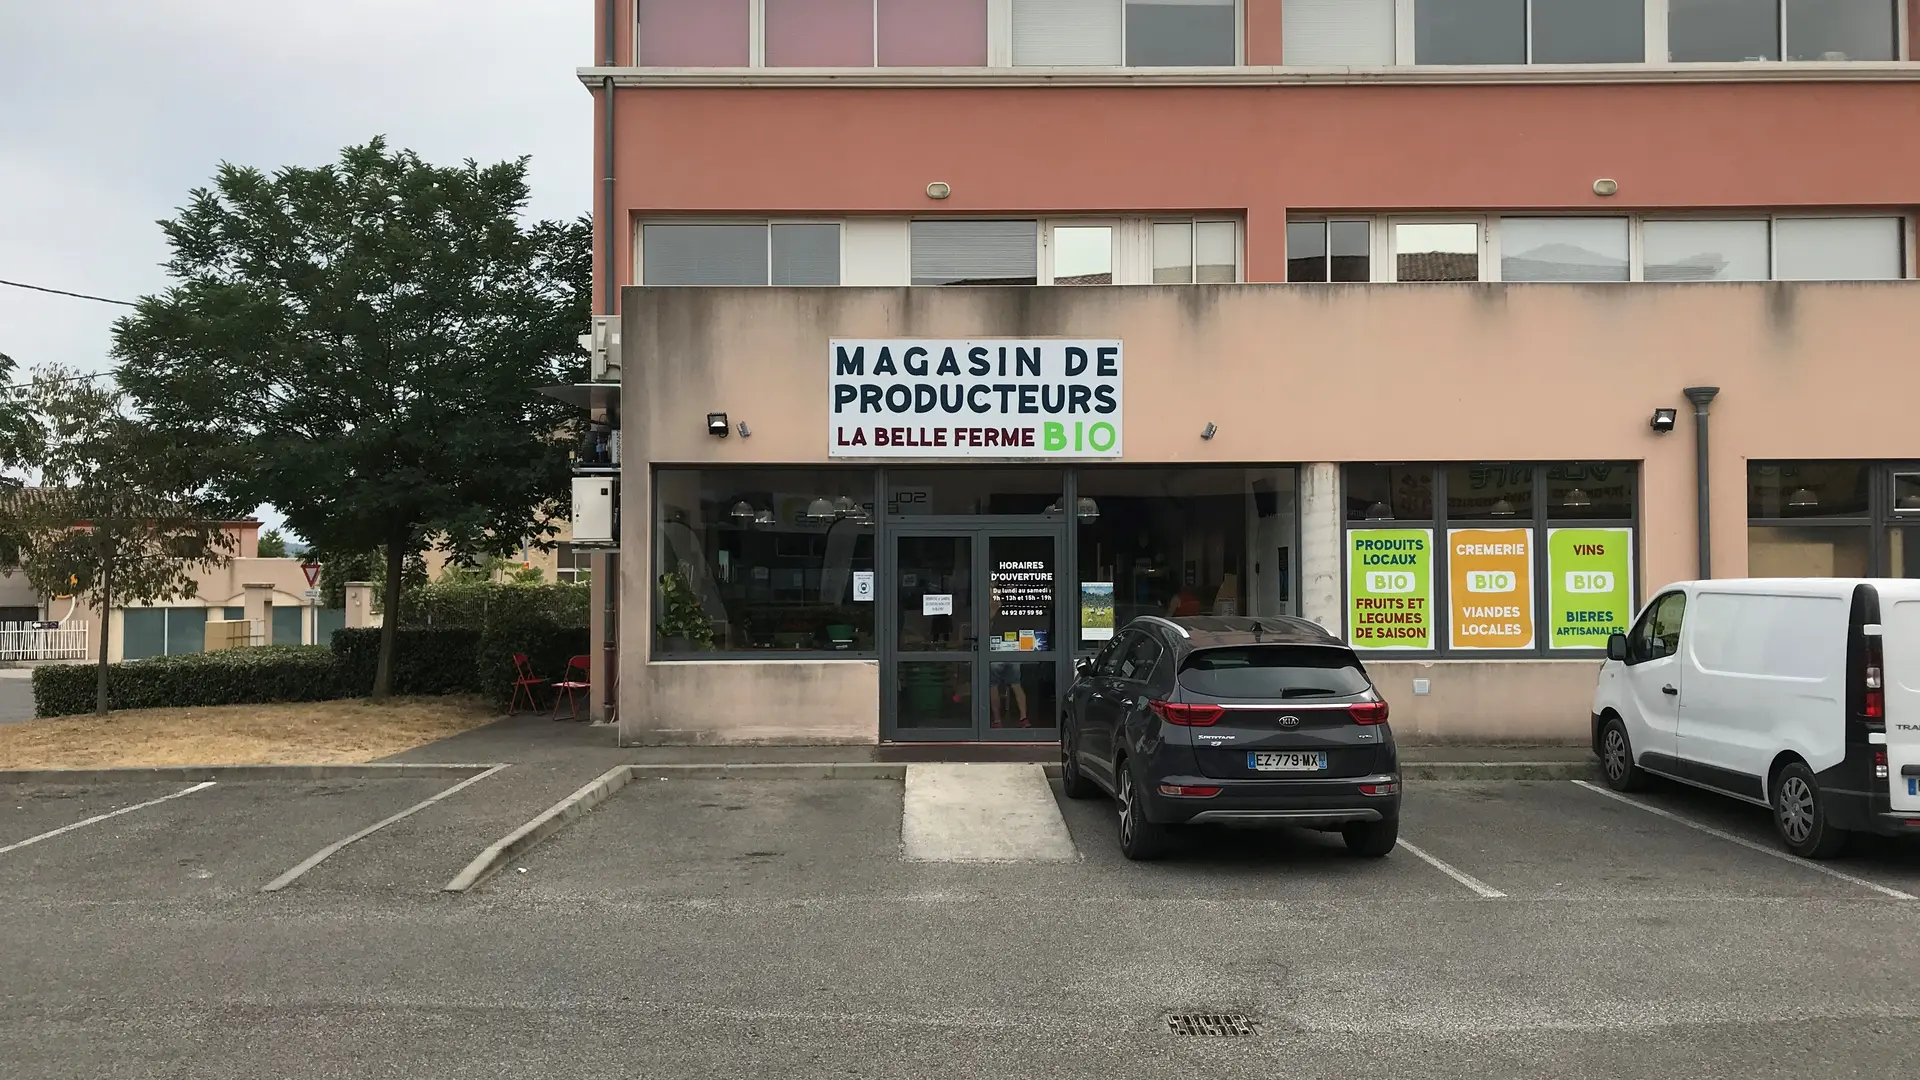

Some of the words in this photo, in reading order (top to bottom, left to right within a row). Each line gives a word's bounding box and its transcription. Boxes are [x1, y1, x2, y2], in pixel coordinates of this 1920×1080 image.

[836, 346, 1041, 376] MAGASIN
[1065, 346, 1118, 376] DE
[834, 384, 1117, 414] PRODUCTEURS
[837, 427, 867, 446] LA
[874, 427, 947, 446] BELLE
[954, 427, 1035, 446] FERME
[1043, 421, 1116, 451] BIO
[1356, 539, 1423, 551] PRODUITS
[1456, 544, 1524, 555] CREMERIE
[1573, 544, 1605, 555] VINS
[999, 561, 1044, 569] HORAIRES
[1363, 554, 1416, 565] LOCAUX
[991, 572, 1053, 580] D'OUVERTURE
[1475, 574, 1508, 589] BIO
[1573, 574, 1606, 590] BIO
[1374, 575, 1407, 590] BIO
[1356, 598, 1404, 609] FRUITS
[1408, 598, 1424, 609] ET
[1359, 612, 1422, 624] LEGUMES
[1463, 606, 1520, 618] VIANDES
[1566, 611, 1614, 622] BIERES
[1356, 627, 1373, 639] DE
[1376, 627, 1426, 639] SAISON
[1461, 623, 1522, 635] LOCALES
[1556, 626, 1624, 636] ARTISANALES
[1256, 754, 1318, 766] EZ-779-MX
